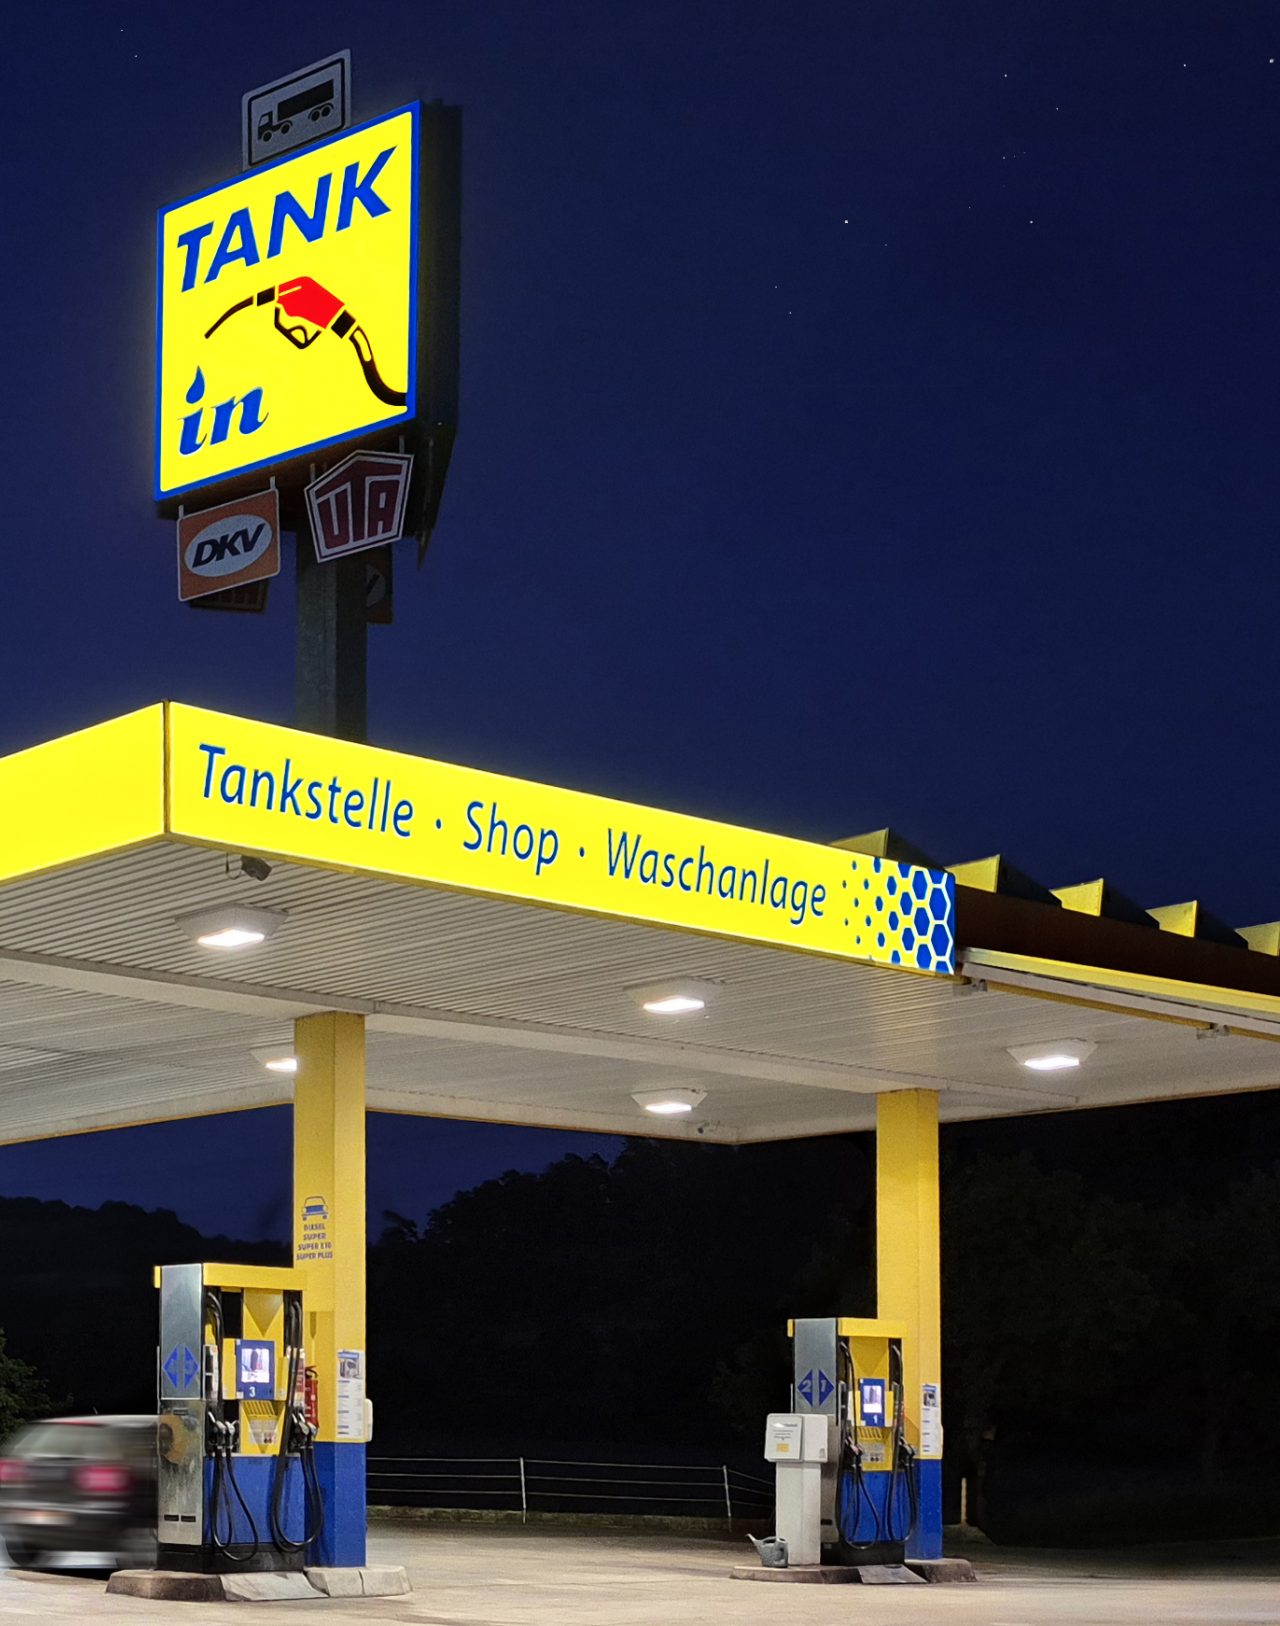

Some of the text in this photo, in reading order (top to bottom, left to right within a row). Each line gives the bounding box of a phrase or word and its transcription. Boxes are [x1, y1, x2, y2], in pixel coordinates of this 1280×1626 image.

[176, 146, 397, 293] TANK
[176, 366, 269, 456] in
[315, 461, 403, 550] UTA
[192, 523, 266, 569] DKV
[198, 743, 827, 926] Tankstelle Shop Waschanlage
[298, 1243, 319, 1251] SUPER
[249, 1386, 256, 1398] 3
[802, 1380, 812, 1393] 2
[820, 1380, 827, 1393] 1
